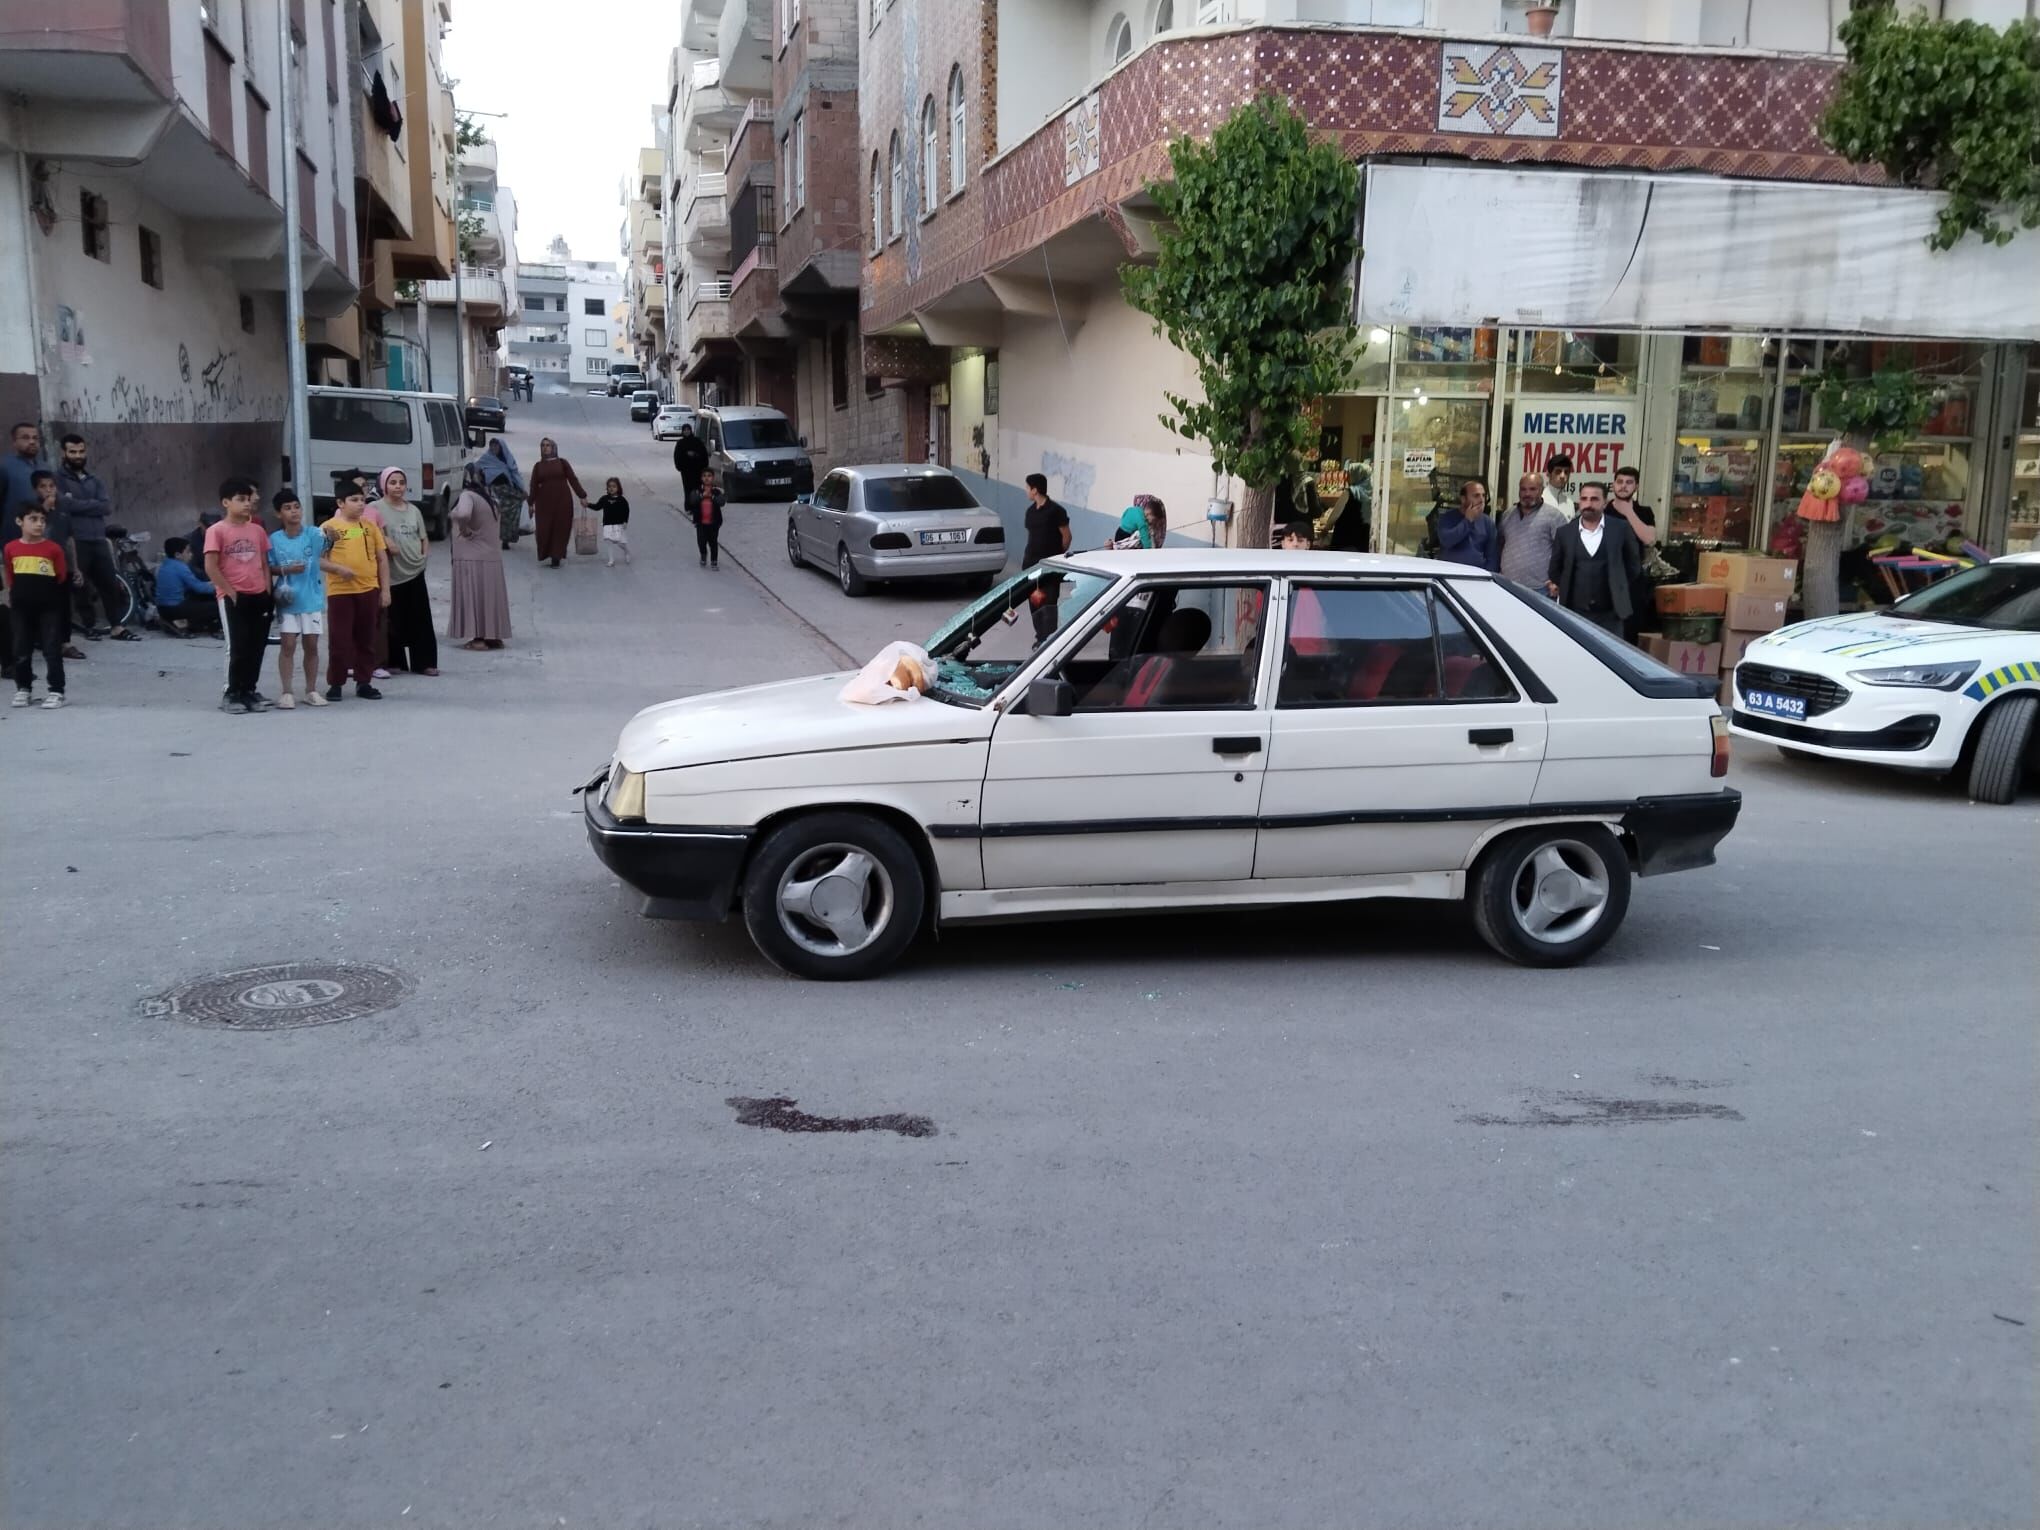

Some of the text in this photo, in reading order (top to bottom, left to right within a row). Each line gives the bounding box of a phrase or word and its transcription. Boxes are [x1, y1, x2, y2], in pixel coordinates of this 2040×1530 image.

[1524, 413, 1626, 434] MERMER
[1523, 442, 1624, 473] MARKET
[1748, 692, 1763, 706] 63
[1764, 695, 1774, 708] A
[1776, 697, 1804, 714] 5432
